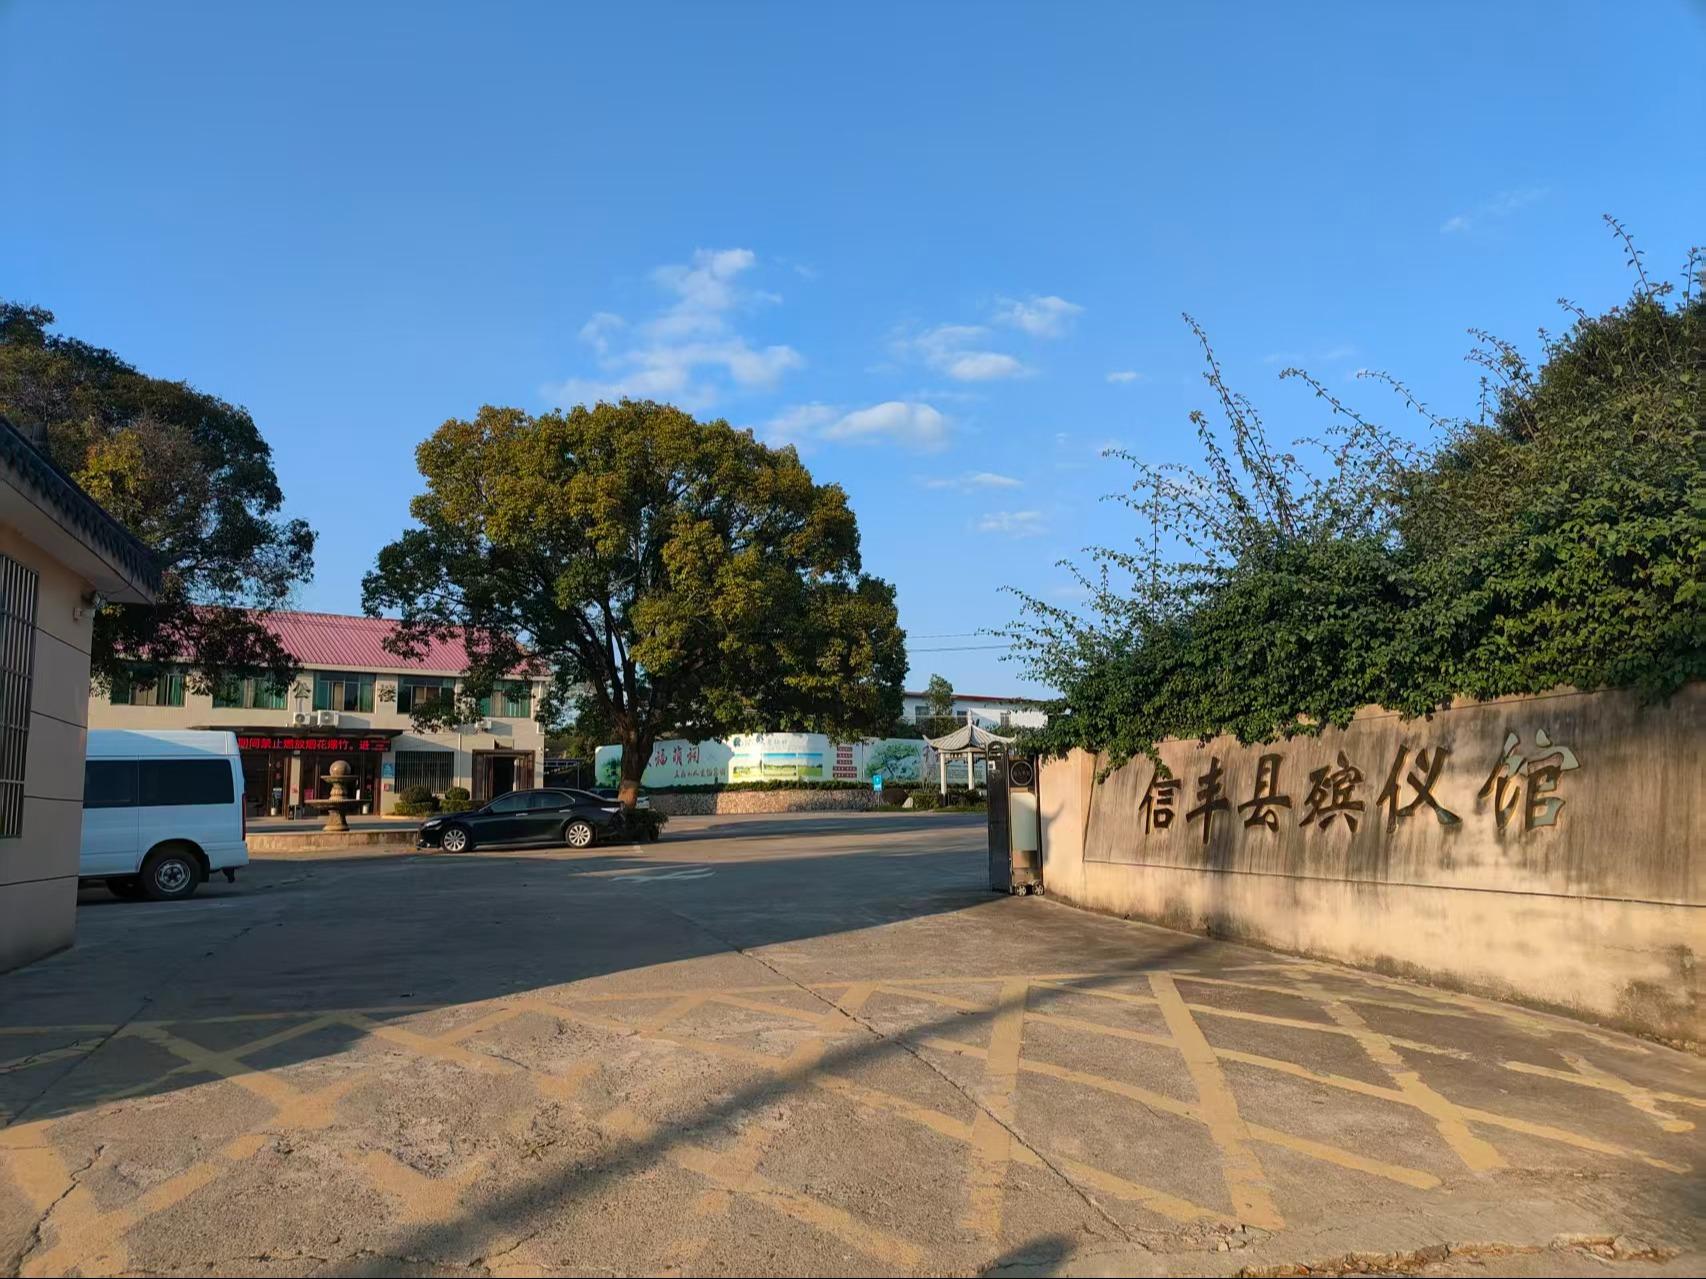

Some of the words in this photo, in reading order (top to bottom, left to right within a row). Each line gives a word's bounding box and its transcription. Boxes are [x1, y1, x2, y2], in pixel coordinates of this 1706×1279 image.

[1138, 728, 1580, 844] 信丰县殡仪馆
